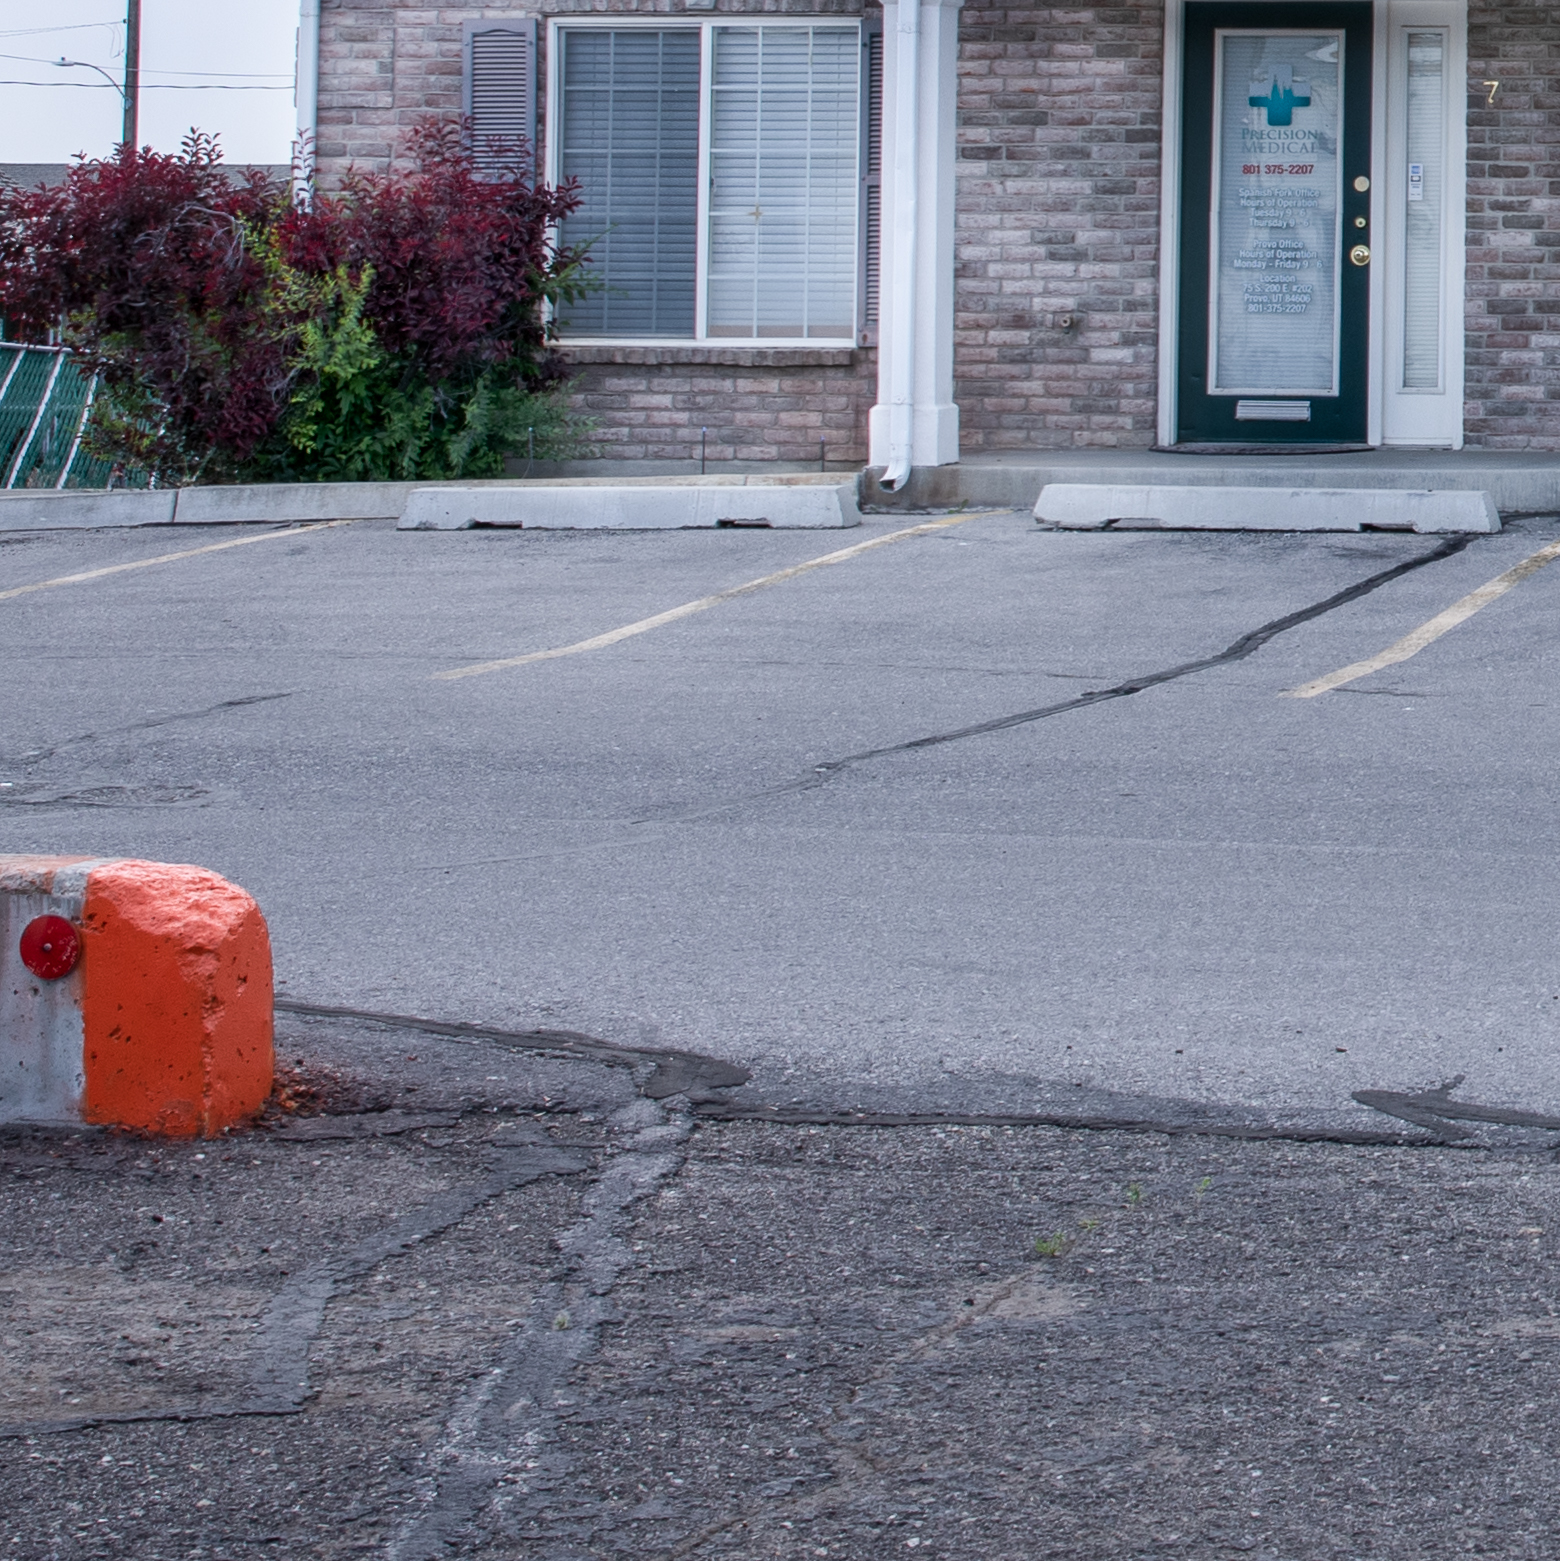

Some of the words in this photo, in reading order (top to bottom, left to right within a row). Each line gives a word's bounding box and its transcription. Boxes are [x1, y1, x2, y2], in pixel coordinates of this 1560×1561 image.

[1483, 81, 1499, 104] 7
[1241, 128, 1318, 140] PRECISION
[1241, 141, 1318, 153] MEDICAL
[1242, 164, 1261, 174] 801
[1264, 164, 1314, 174] 375-2207
[1239, 188, 1272, 198] Spanish
[1275, 188, 1292, 197] Fork
[1296, 188, 1320, 197] Office
[1240, 198, 1265, 207] Hours
[1266, 198, 1276, 206] of
[1277, 198, 1318, 208] Operation
[1251, 208, 1284, 218] Tuesday
[1249, 218, 1288, 229] Thursday
[1253, 240, 1277, 248] Provo
[1279, 240, 1304, 248] Office
[1240, 250, 1264, 258] Hours
[1266, 250, 1275, 258] of
[1276, 250, 1317, 259] Operation
[1234, 260, 1267, 269] Monday
[1275, 260, 1301, 270] Friday
[1302, 260, 1309, 268] 9
[1260, 274, 1296, 282] Location
[1265, 284, 1280, 292] 200
[1272, 294, 1283, 302] UT
[1248, 304, 1306, 312] 801-375-2207
